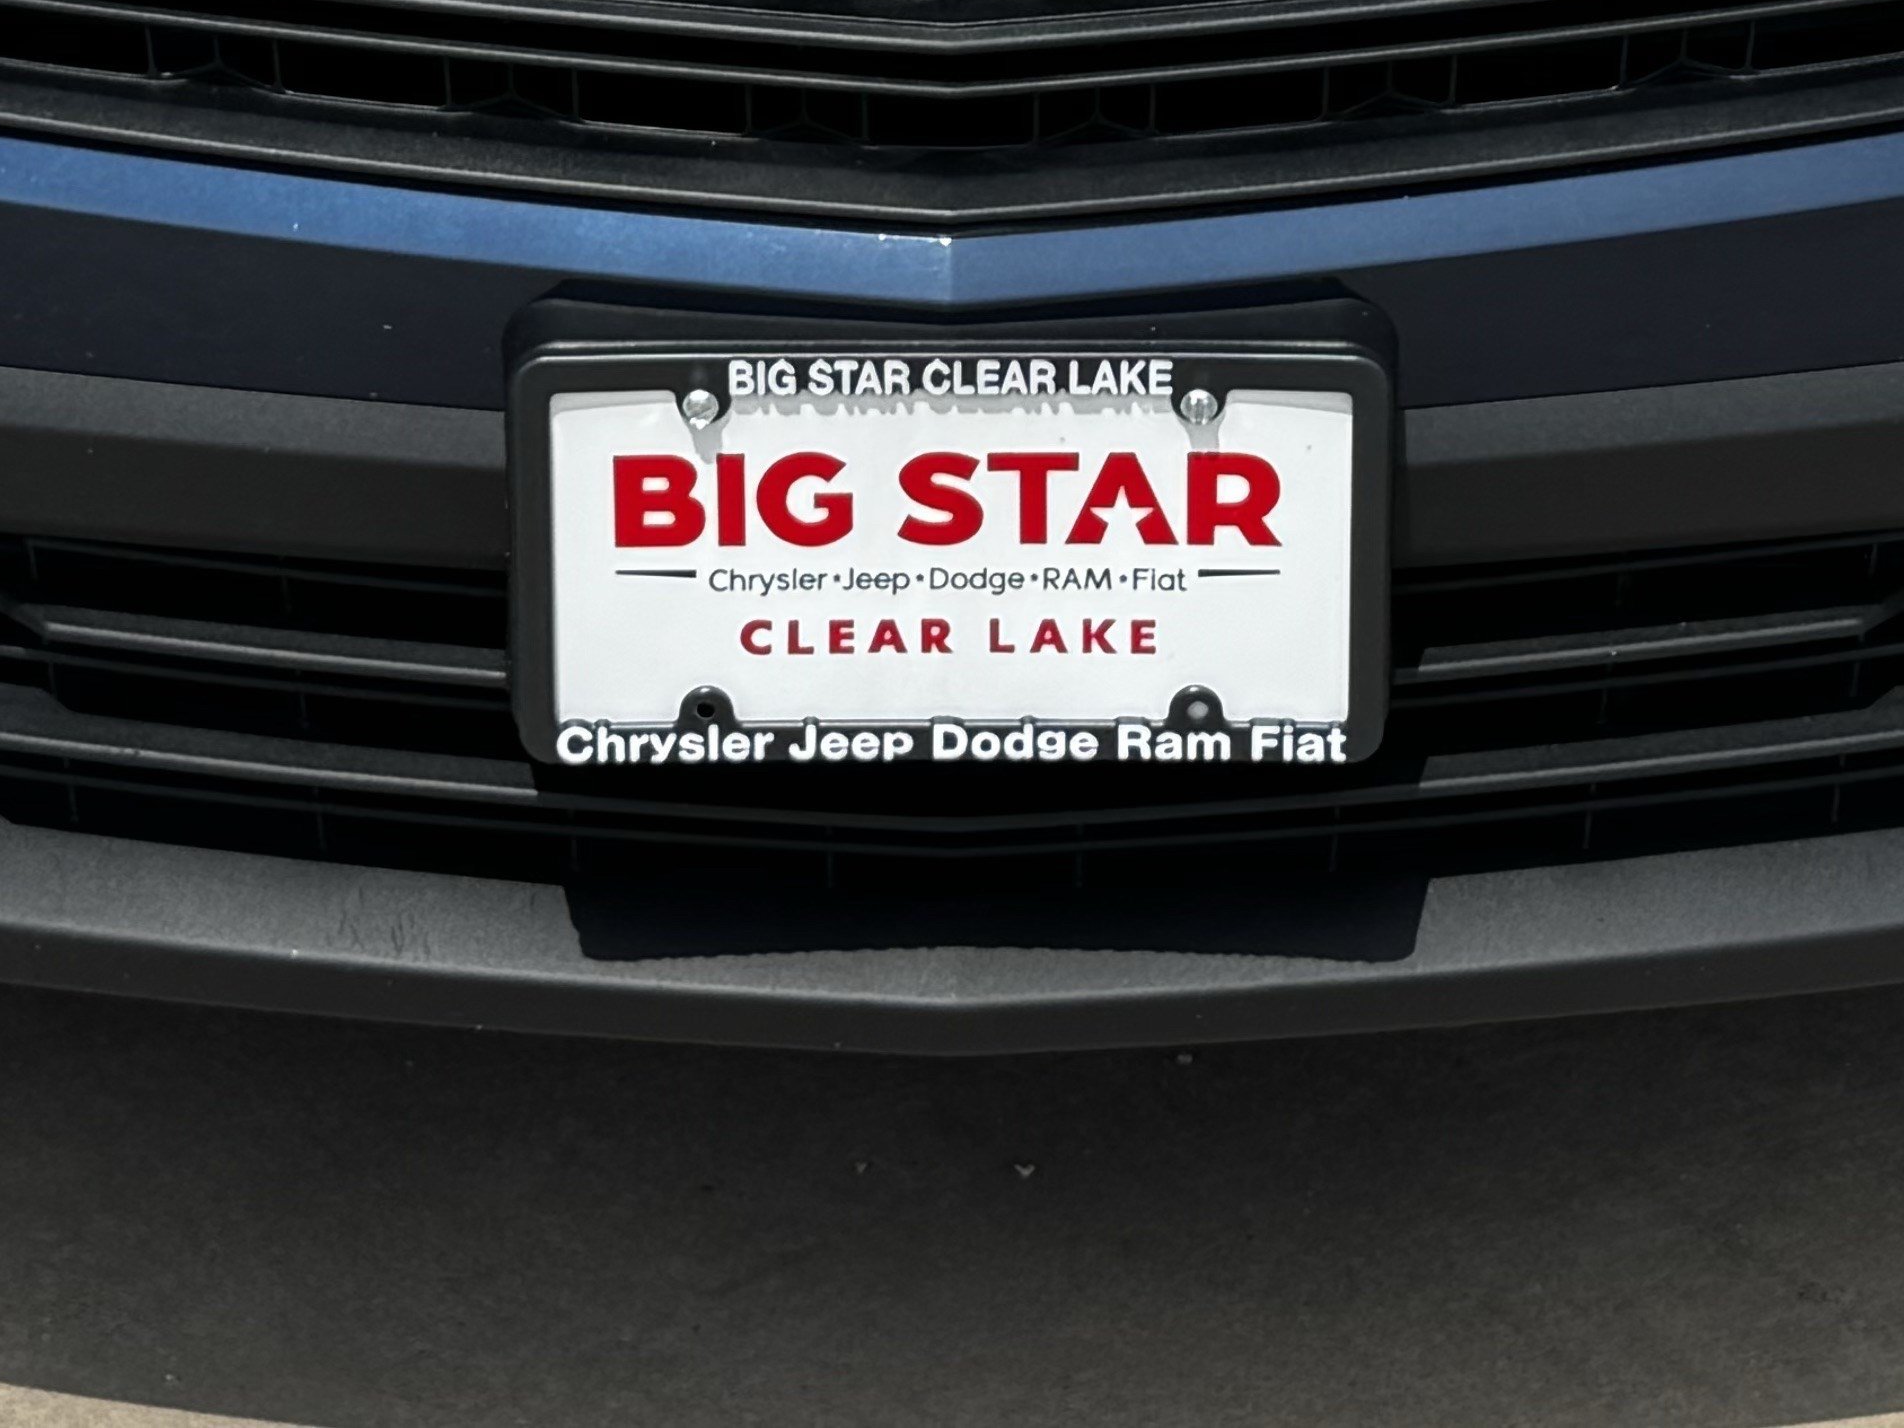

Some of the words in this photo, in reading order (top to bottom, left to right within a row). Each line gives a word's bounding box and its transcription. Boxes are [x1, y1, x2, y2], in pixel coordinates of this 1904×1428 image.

[727, 359, 797, 395] BIG
[807, 358, 911, 395] STAR
[922, 358, 1056, 396] CLEAR
[1069, 360, 1173, 396] LAKE
[614, 452, 854, 547] BIG
[897, 452, 1282, 546] STAR
[708, 568, 828, 597] Chrysler
[842, 568, 911, 596] Jeep
[929, 567, 1025, 596] Dodge
[1043, 567, 1112, 590] RAM
[1132, 567, 1187, 592] Fiat
[740, 619, 952, 655] CLEAR
[989, 619, 1159, 654] LAKE
[556, 724, 774, 764] Chrysler
[788, 724, 914, 762] Jeep
[931, 724, 1099, 762] Dodge
[1117, 725, 1231, 761] Ram
[1251, 725, 1347, 762] Fiat
